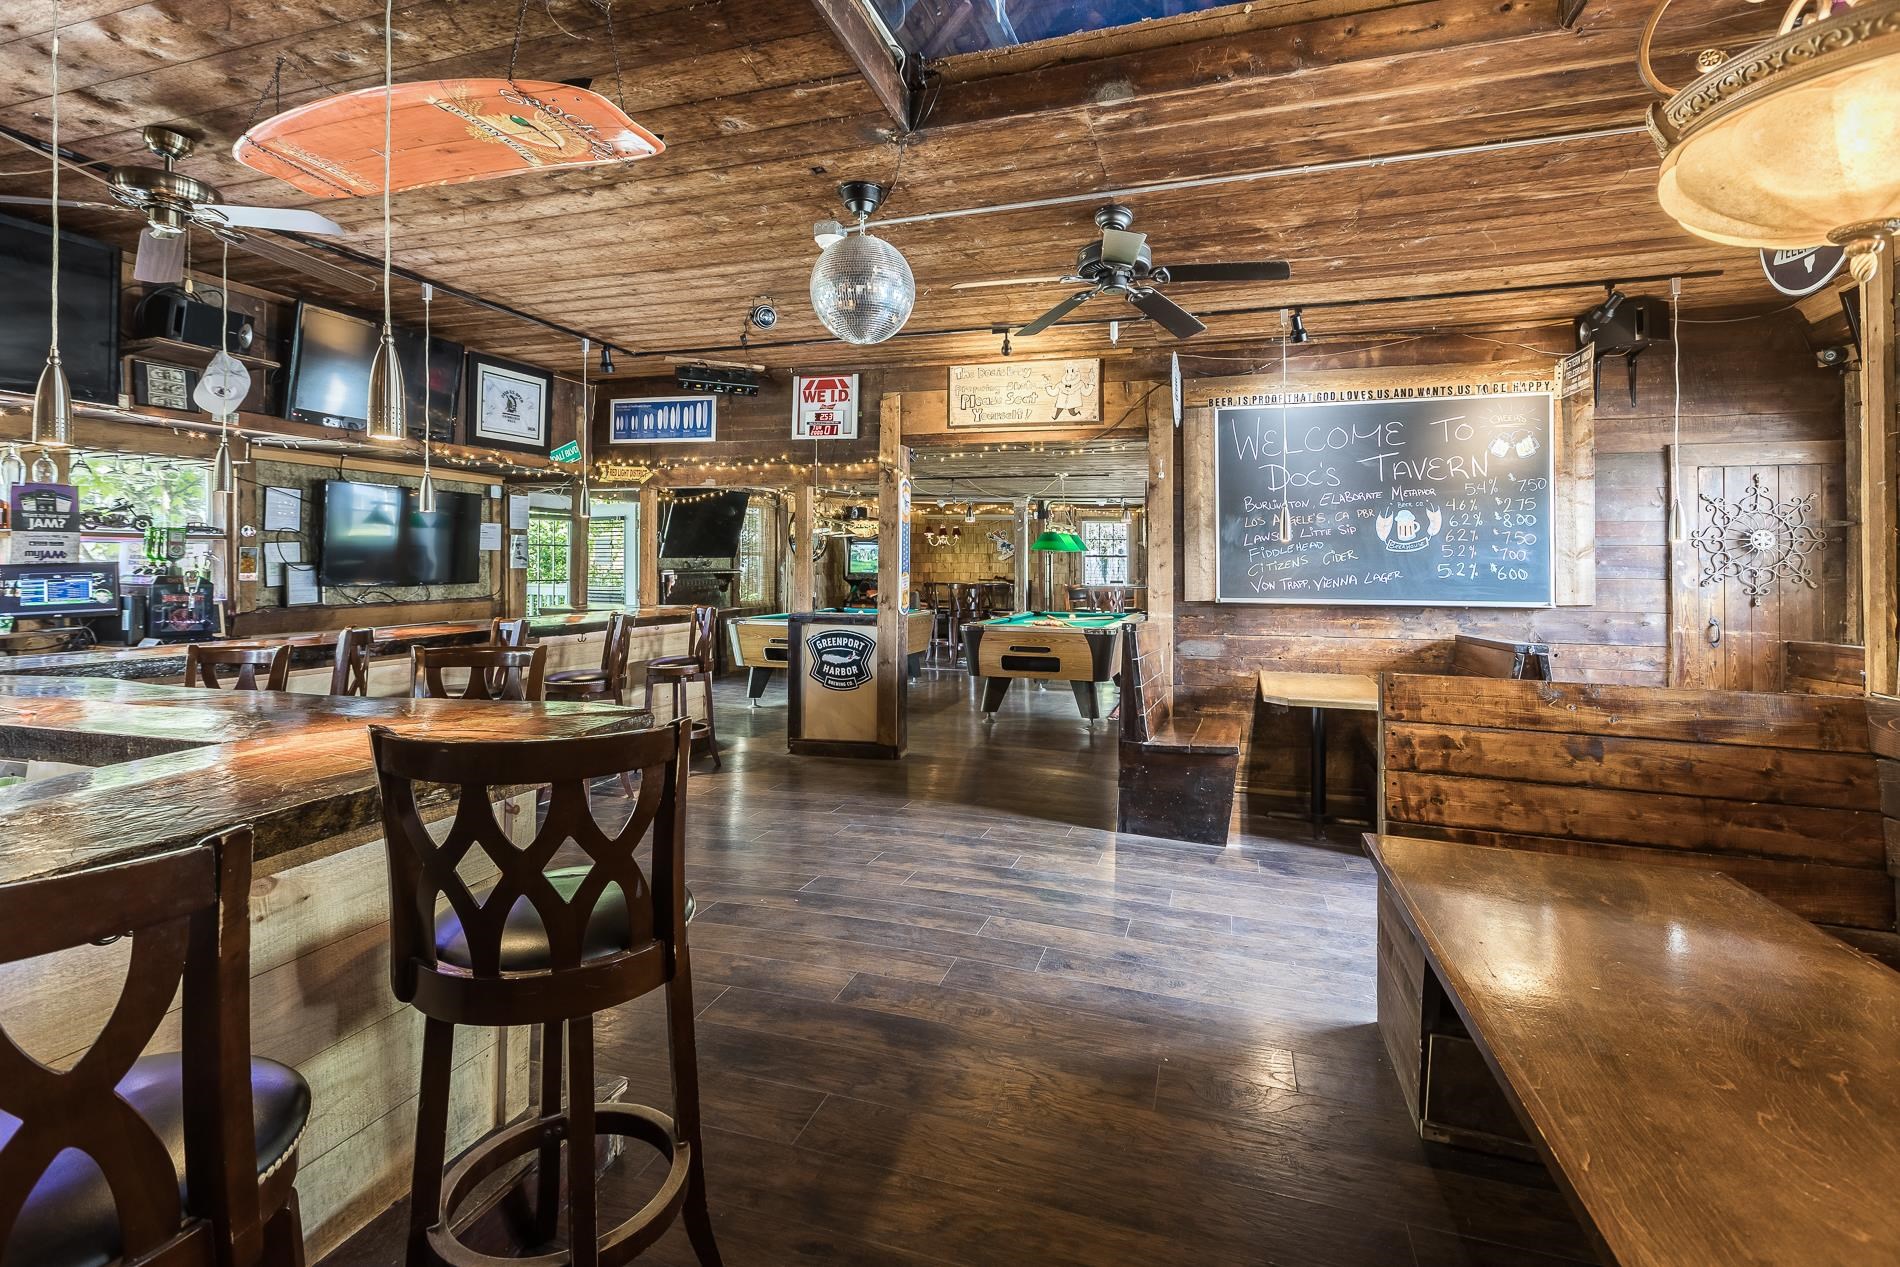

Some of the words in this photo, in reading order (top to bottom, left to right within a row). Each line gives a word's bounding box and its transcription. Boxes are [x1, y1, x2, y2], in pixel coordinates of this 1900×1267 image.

[446, 104, 501, 137] BELGIAN
[802, 390, 826, 403] WE
[830, 389, 851, 402] I.D.
[961, 394, 1002, 410] Please
[1006, 391, 1039, 405] Seat
[1208, 398, 1233, 408] BEER
[1238, 397, 1248, 406] IS
[1252, 393, 1283, 405] PROOF
[1287, 392, 1313, 403] THAT
[1316, 391, 1336, 402] GOD
[1339, 389, 1374, 401] LOVES
[1376, 389, 1390, 399] US
[1393, 388, 1414, 399] AND
[1417, 385, 1453, 398] WANTS
[1457, 384, 1471, 395] US
[1475, 383, 1489, 395] TO
[1493, 382, 1507, 393] BE
[1231, 416, 1407, 461] WELCOME
[1428, 415, 1474, 443] TO
[1355, 449, 1489, 483] TAVERN
[1243, 496, 1316, 513] BURLINTON,
[1319, 491, 1383, 506] ELABORATE
[1391, 485, 1437, 502] METAPHOR
[1464, 477, 1499, 496] 5.4%
[27, 518, 67, 530] JAM?
[1244, 517, 1266, 528] LOS
[1272, 513, 1330, 527] AGELE'S,
[1335, 511, 1350, 522] CA
[1357, 508, 1376, 518] PBR
[1300, 527, 1332, 538] LITTLE
[1250, 576, 1276, 594] VON
[1313, 575, 1358, 592] VIENNA
[1364, 571, 1404, 585] LAGER
[816, 636, 866, 651] GREENPORT
[822, 664, 859, 676] HARBOR
